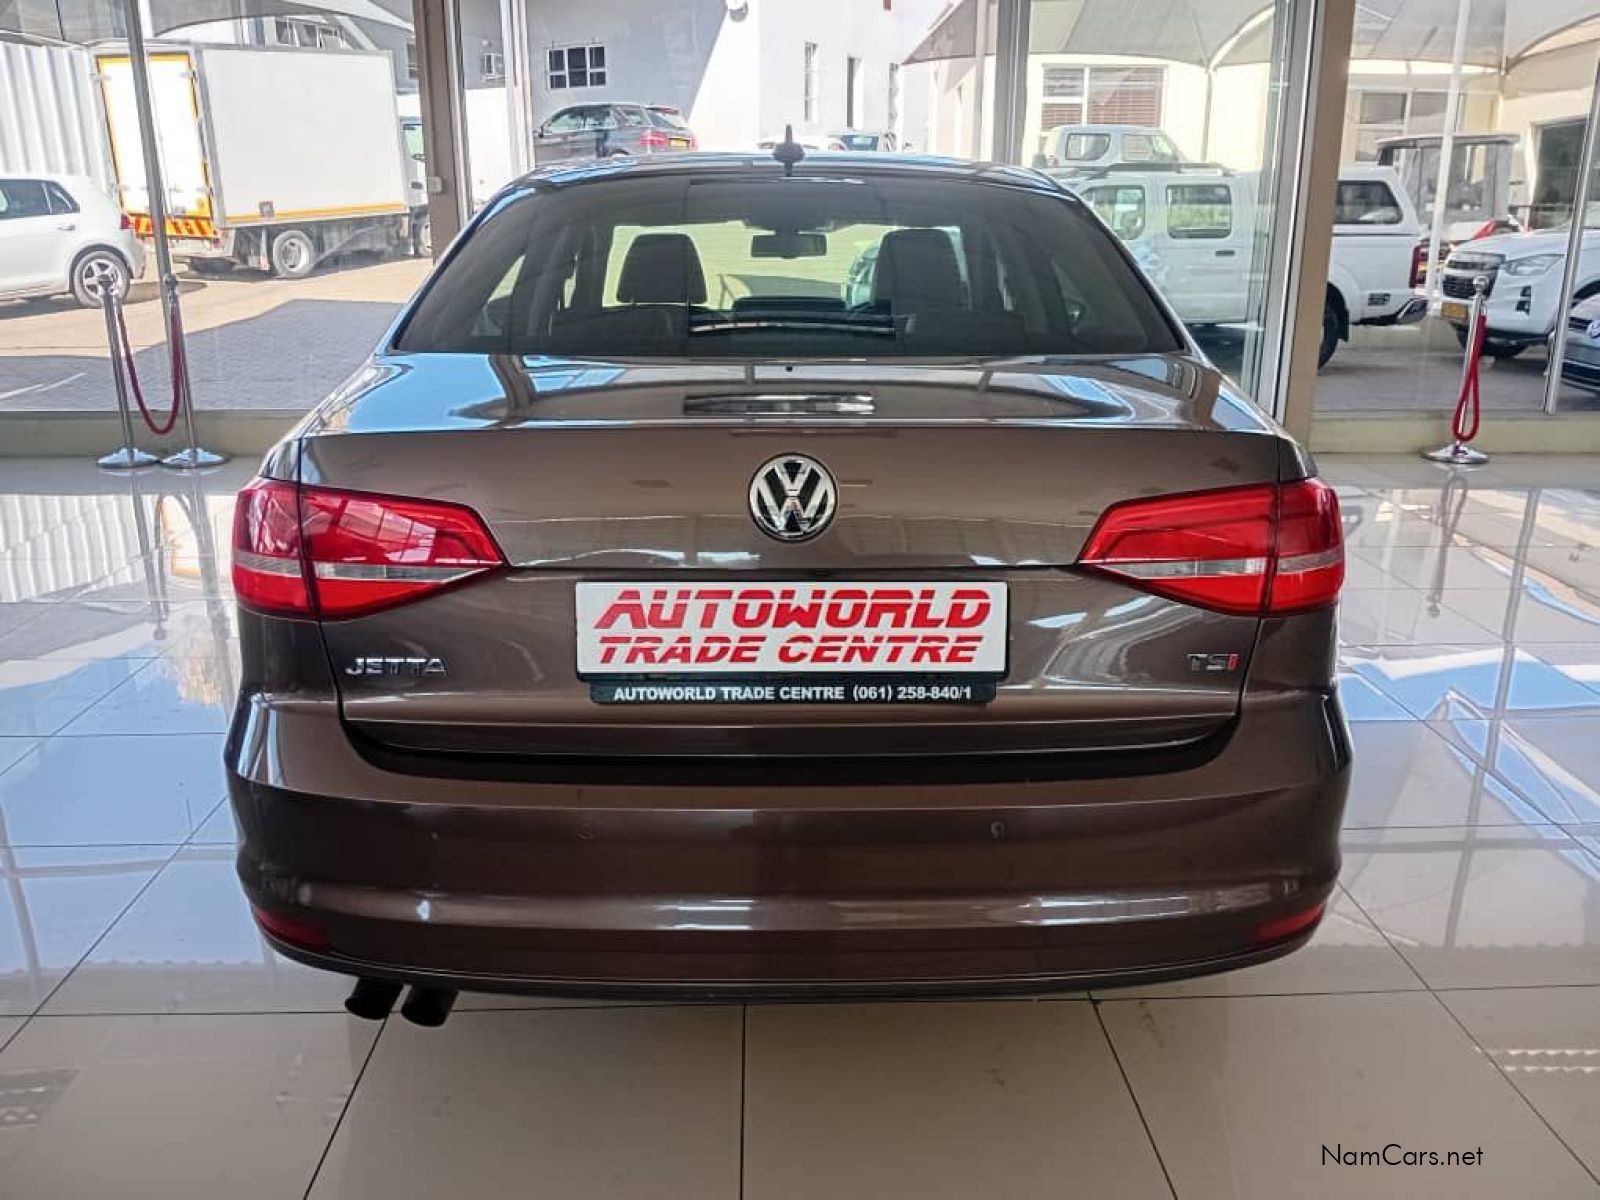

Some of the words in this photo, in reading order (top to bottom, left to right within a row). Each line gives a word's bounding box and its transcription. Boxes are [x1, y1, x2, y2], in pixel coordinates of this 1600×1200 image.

[594, 589, 992, 630] AUTOWORLD
[599, 636, 767, 664] TRADE
[777, 636, 983, 663] CENTRE
[344, 658, 448, 676] JETTA
[613, 687, 716, 701] AUTOWORLD
[720, 687, 775, 700] TRADE
[779, 686, 845, 699] CENTRE
[852, 685, 893, 702] (061)
[897, 686, 972, 699] 258-840/1
